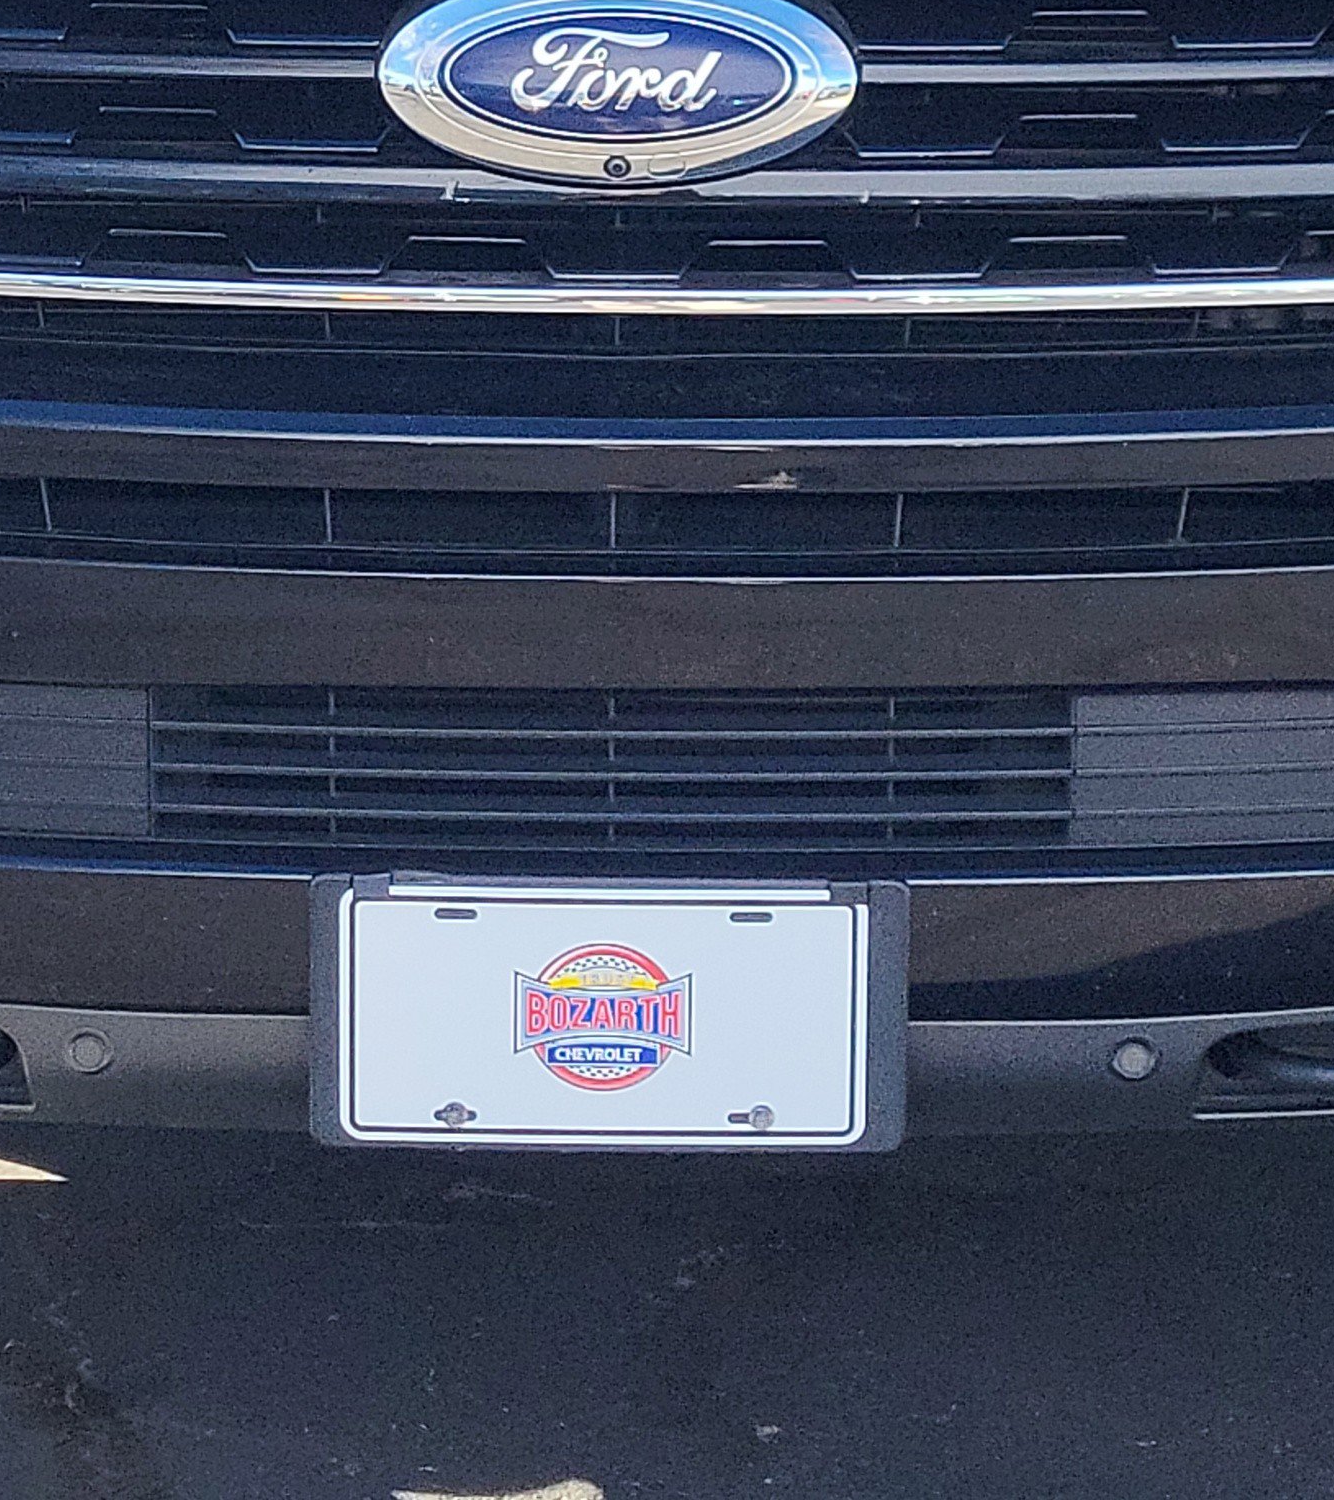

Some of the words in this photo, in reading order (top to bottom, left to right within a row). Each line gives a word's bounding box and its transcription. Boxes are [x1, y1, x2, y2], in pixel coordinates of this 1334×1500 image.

[510, 26, 722, 113] Ford
[525, 990, 682, 1038] BOZARTH
[554, 1046, 644, 1063] CHEVROLET
